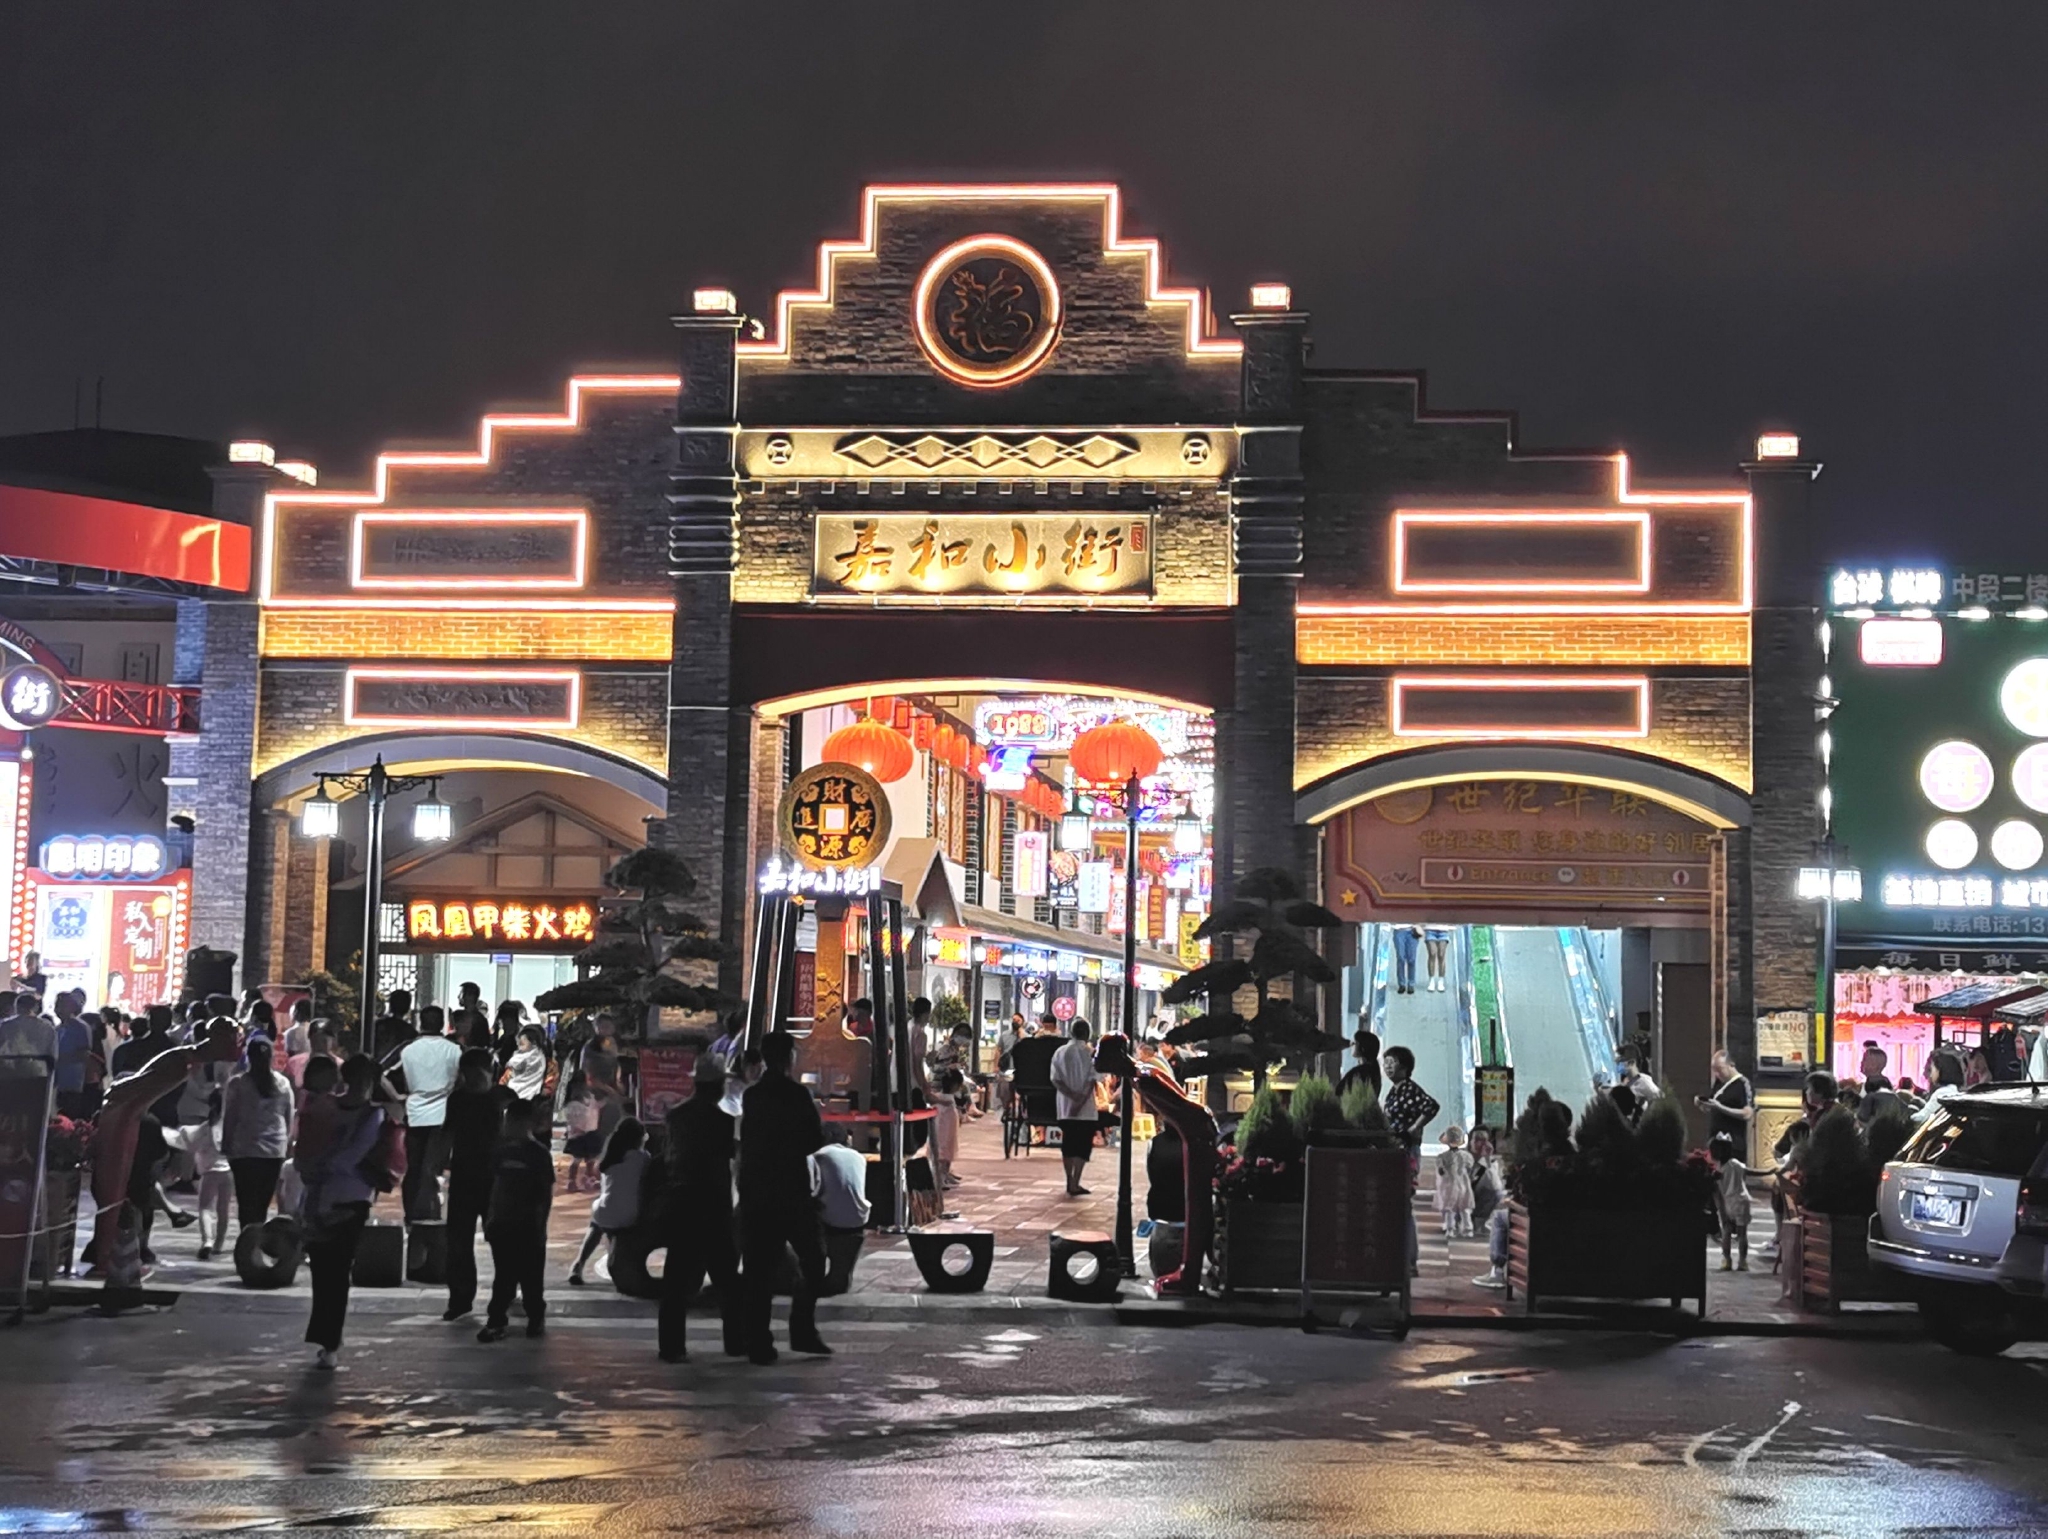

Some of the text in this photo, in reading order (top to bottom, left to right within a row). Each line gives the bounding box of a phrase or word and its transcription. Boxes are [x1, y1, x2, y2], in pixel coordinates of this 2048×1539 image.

[832, 519, 1124, 586] 嘉和小街
[1470, 867, 1552, 883] Entrance
[408, 902, 595, 942] 凤凰甲柴火鸡
[1932, 915, 2048, 934] 联系电话:13
